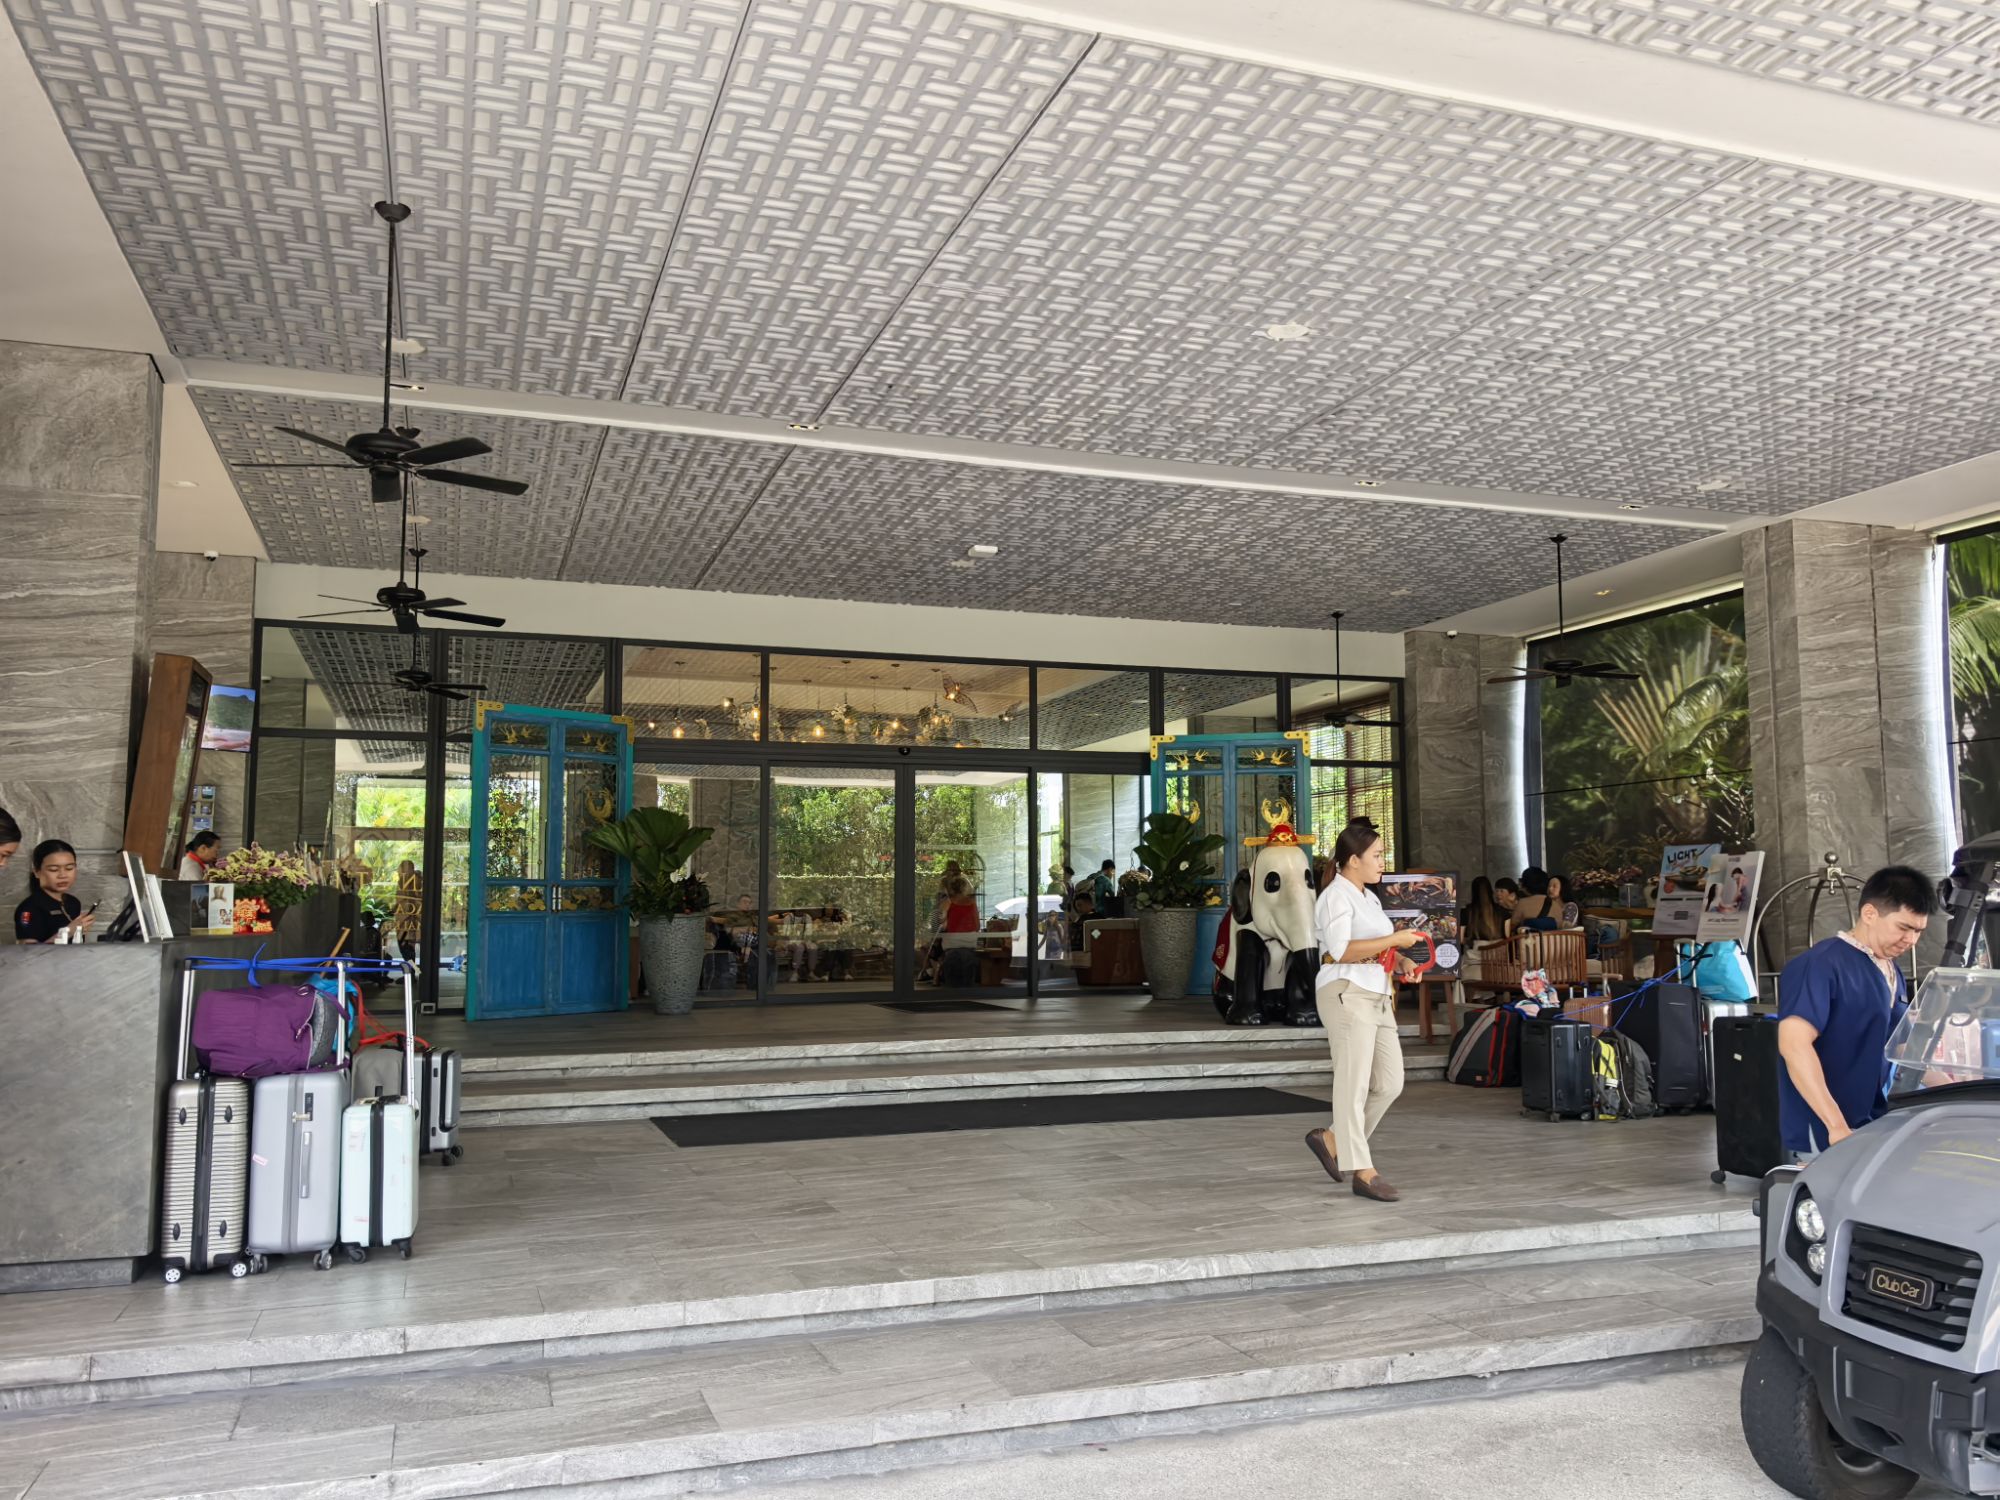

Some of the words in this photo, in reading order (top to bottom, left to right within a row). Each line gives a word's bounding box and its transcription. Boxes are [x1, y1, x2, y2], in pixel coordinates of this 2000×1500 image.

[1667, 848, 1698, 864] LIGHT
[1877, 1275, 1900, 1292] Club
[1900, 1281, 1920, 1298] Car
